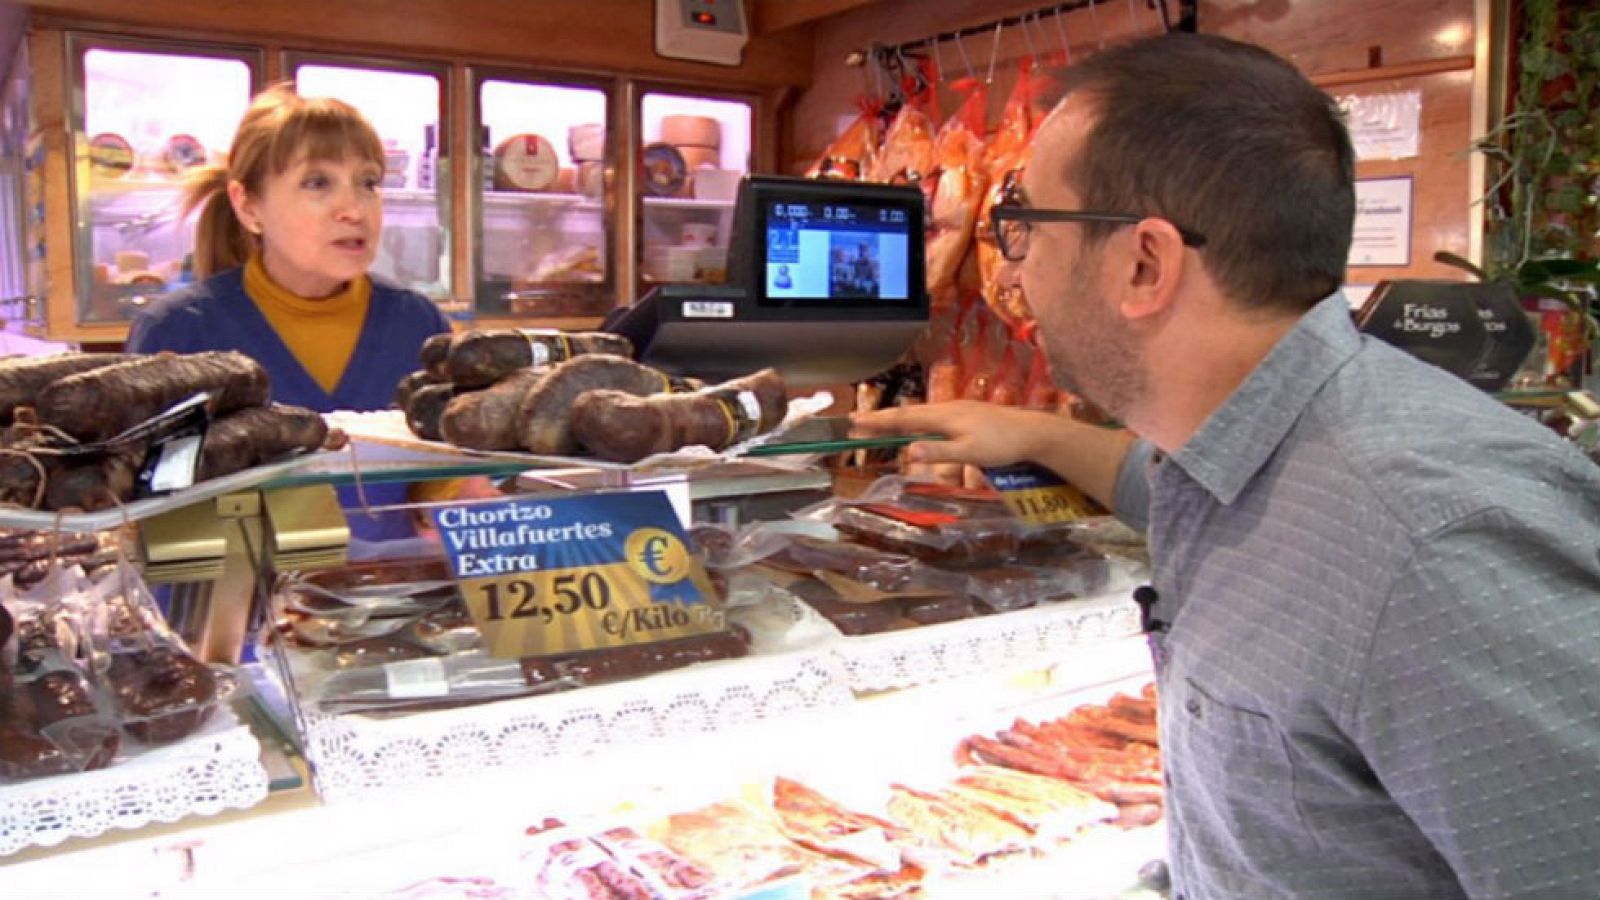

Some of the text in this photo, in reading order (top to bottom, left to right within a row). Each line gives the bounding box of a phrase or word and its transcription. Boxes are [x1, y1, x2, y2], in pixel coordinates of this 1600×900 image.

[1403, 318, 1461, 338] Burgos
[438, 502, 552, 528] Chorizo
[448, 520, 614, 551] Villafuertes
[456, 553, 538, 577] Extra
[479, 571, 611, 624] 12,50
[602, 603, 690, 639] €/Kilo
